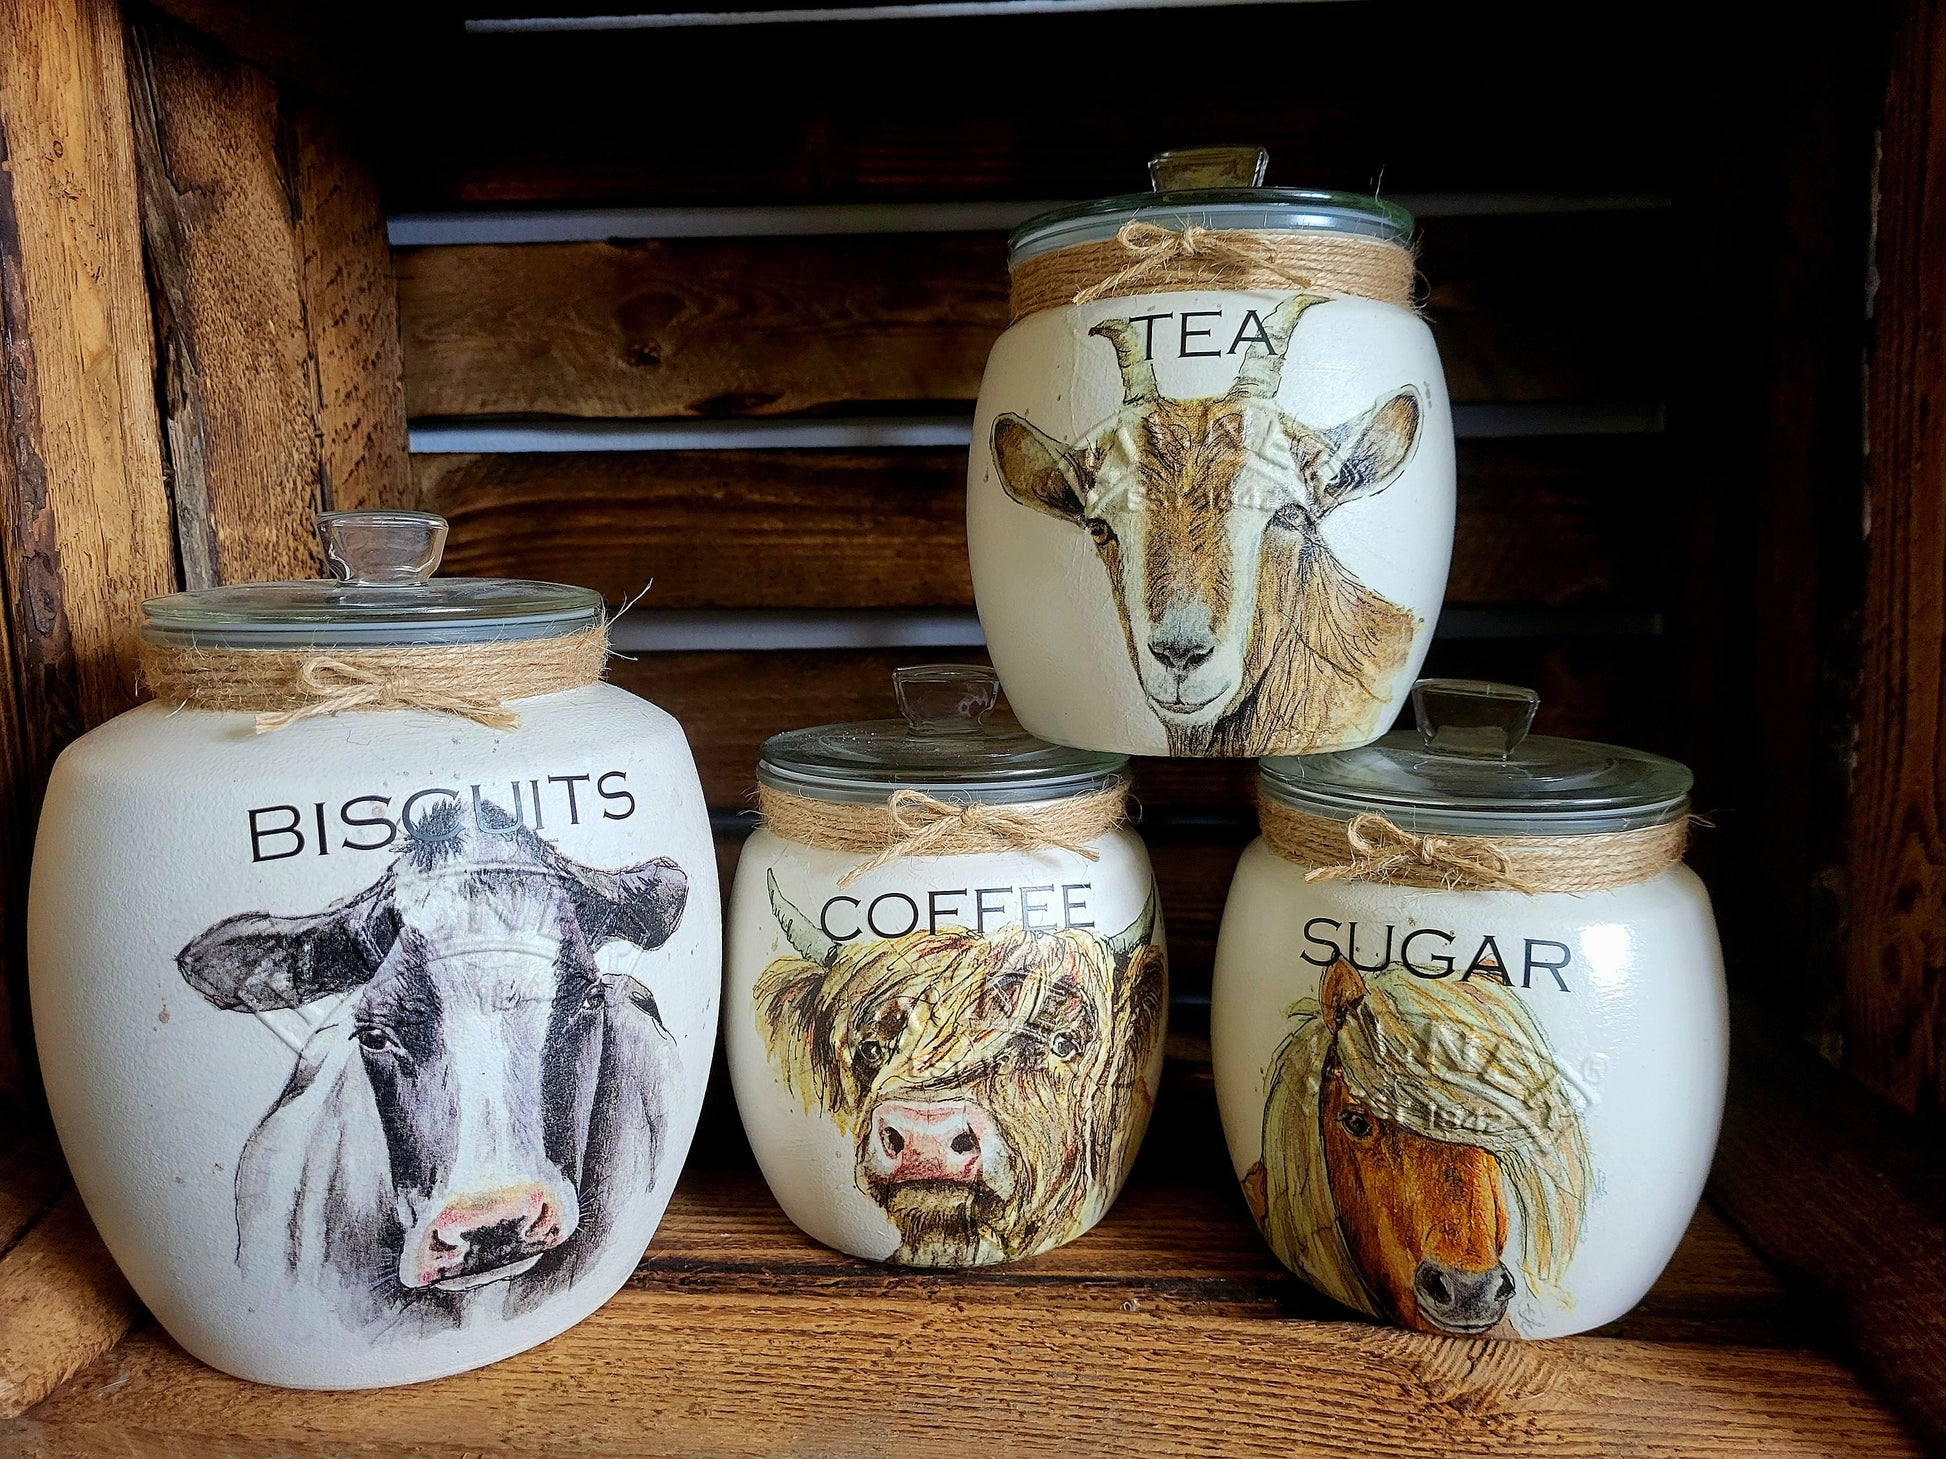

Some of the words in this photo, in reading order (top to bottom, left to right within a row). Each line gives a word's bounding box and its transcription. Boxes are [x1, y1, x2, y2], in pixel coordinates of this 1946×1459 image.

[1129, 309, 1279, 361] TEA
[248, 771, 635, 863] BISCUITS
[820, 882, 1095, 941] COFFEE
[1300, 917, 1571, 993] SUGAR
